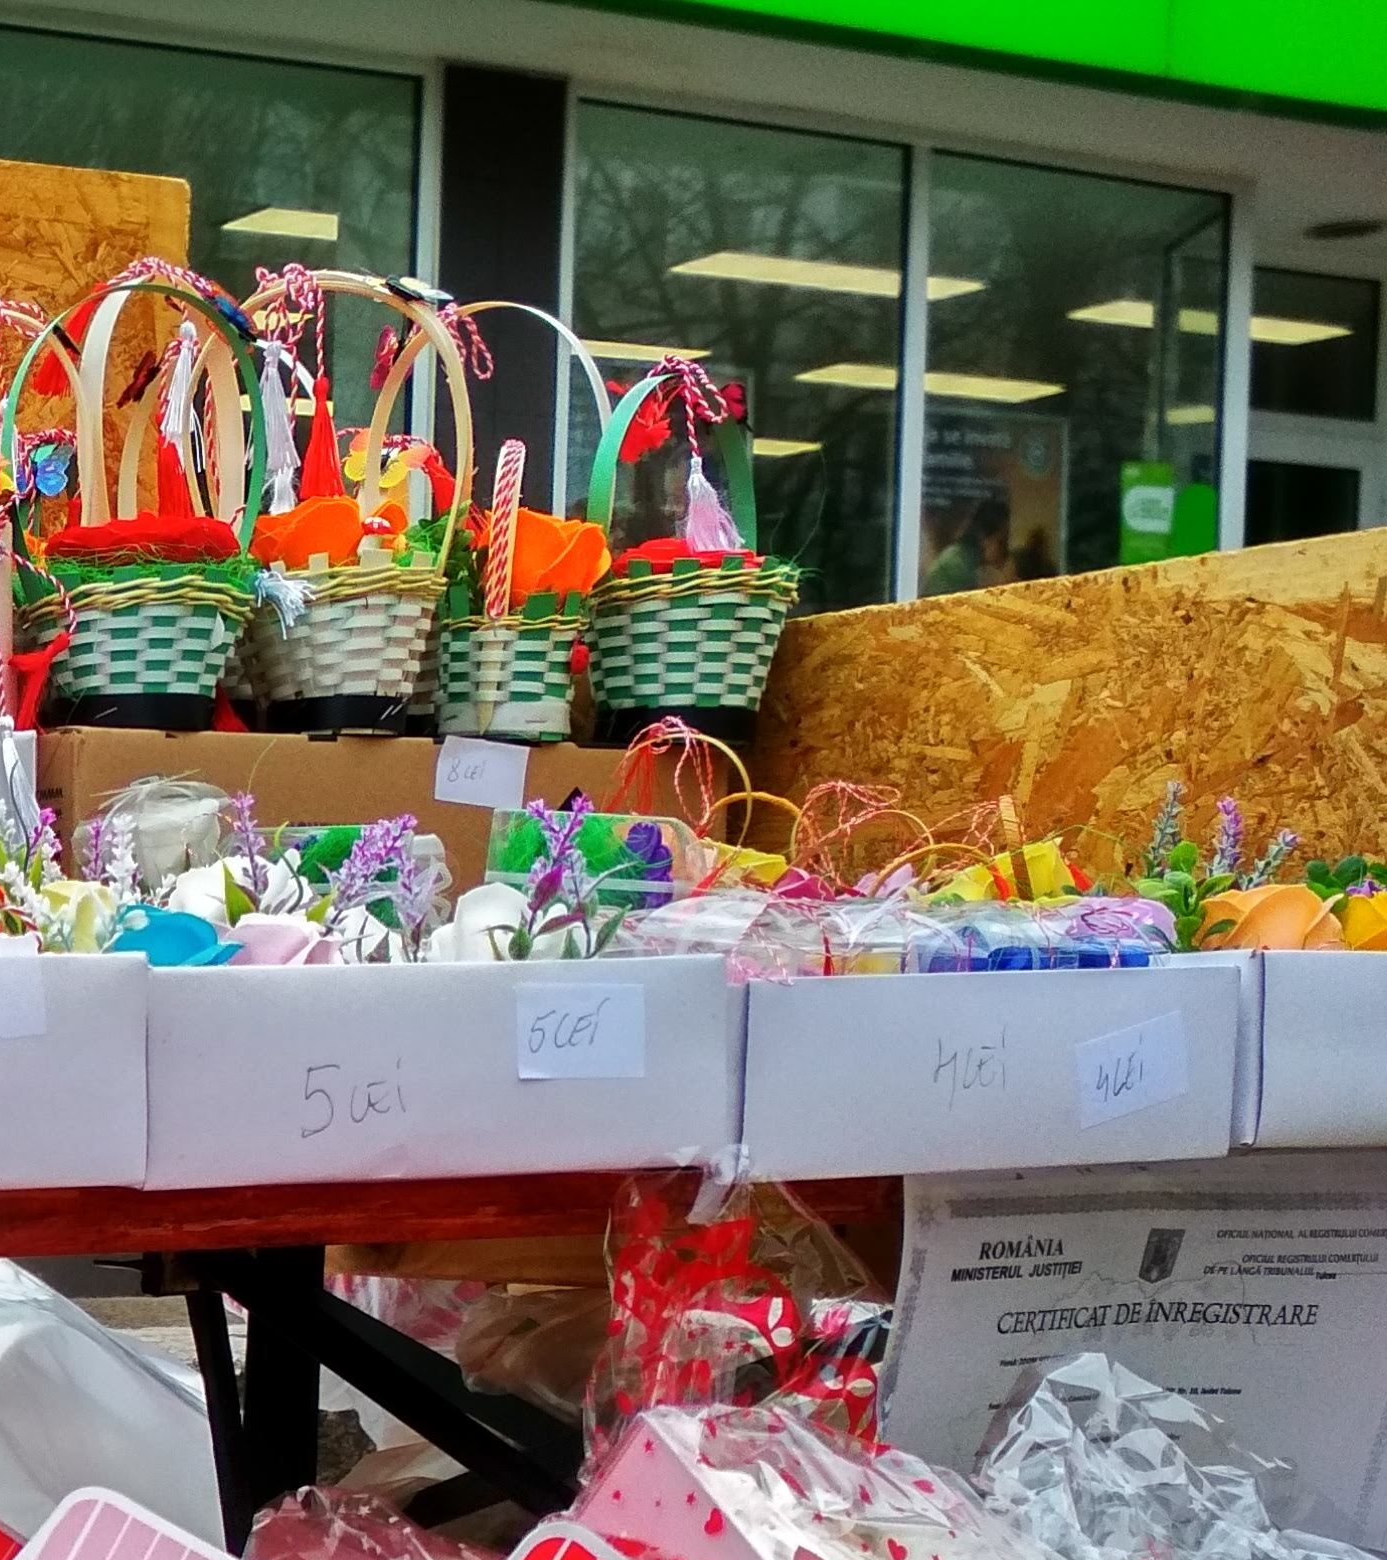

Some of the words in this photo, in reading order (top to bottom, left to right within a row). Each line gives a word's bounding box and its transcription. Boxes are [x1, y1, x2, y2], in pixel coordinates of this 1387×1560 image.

[978, 1234, 1065, 1261] ROMÂNIA
[950, 1263, 1024, 1282] MINISTERUL
[996, 1304, 1112, 1335] CERTIFICAT
[1113, 1303, 1141, 1326] DE
[1144, 1298, 1319, 1329] ÎNREGISTRARE
